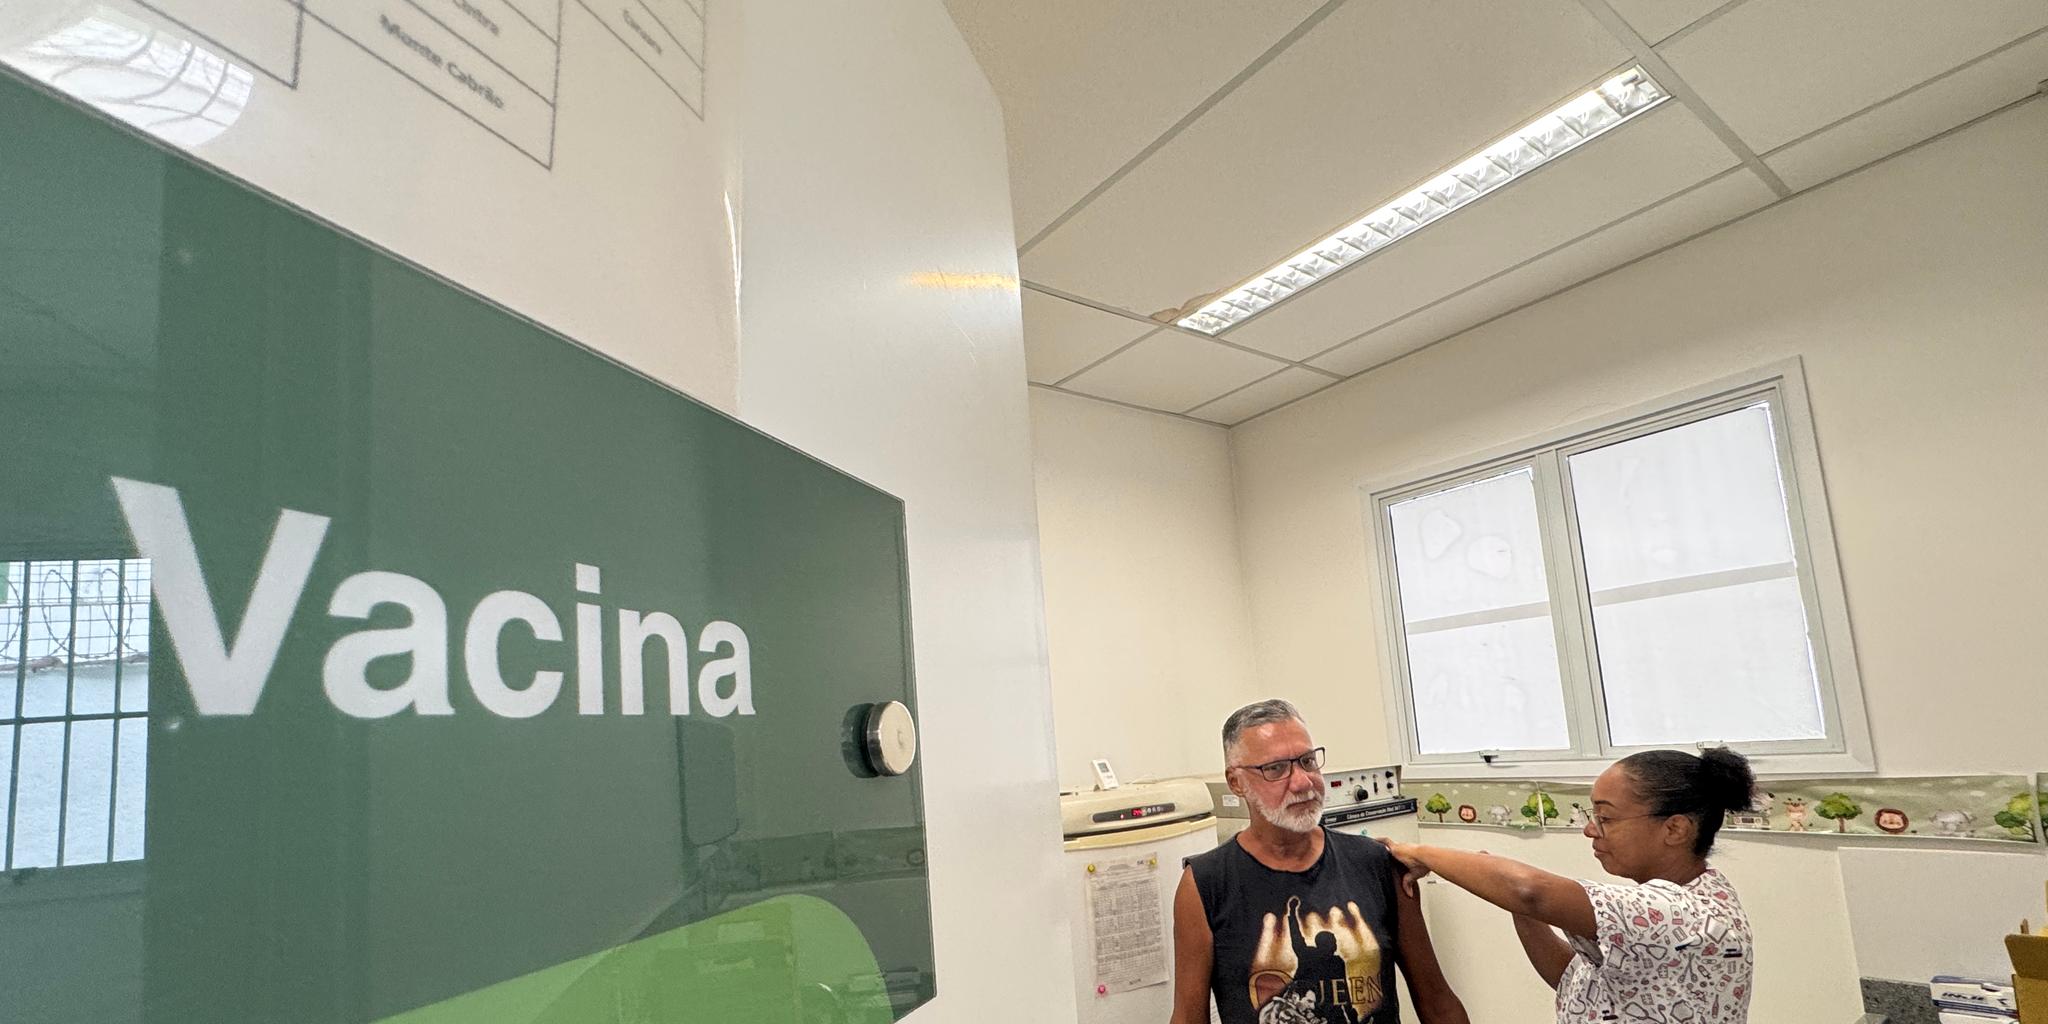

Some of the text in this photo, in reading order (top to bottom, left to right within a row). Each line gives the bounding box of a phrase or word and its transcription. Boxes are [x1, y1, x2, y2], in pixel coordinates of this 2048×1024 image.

[380, 14, 504, 109] Monte Cabrão
[111, 475, 757, 720] Vacina
